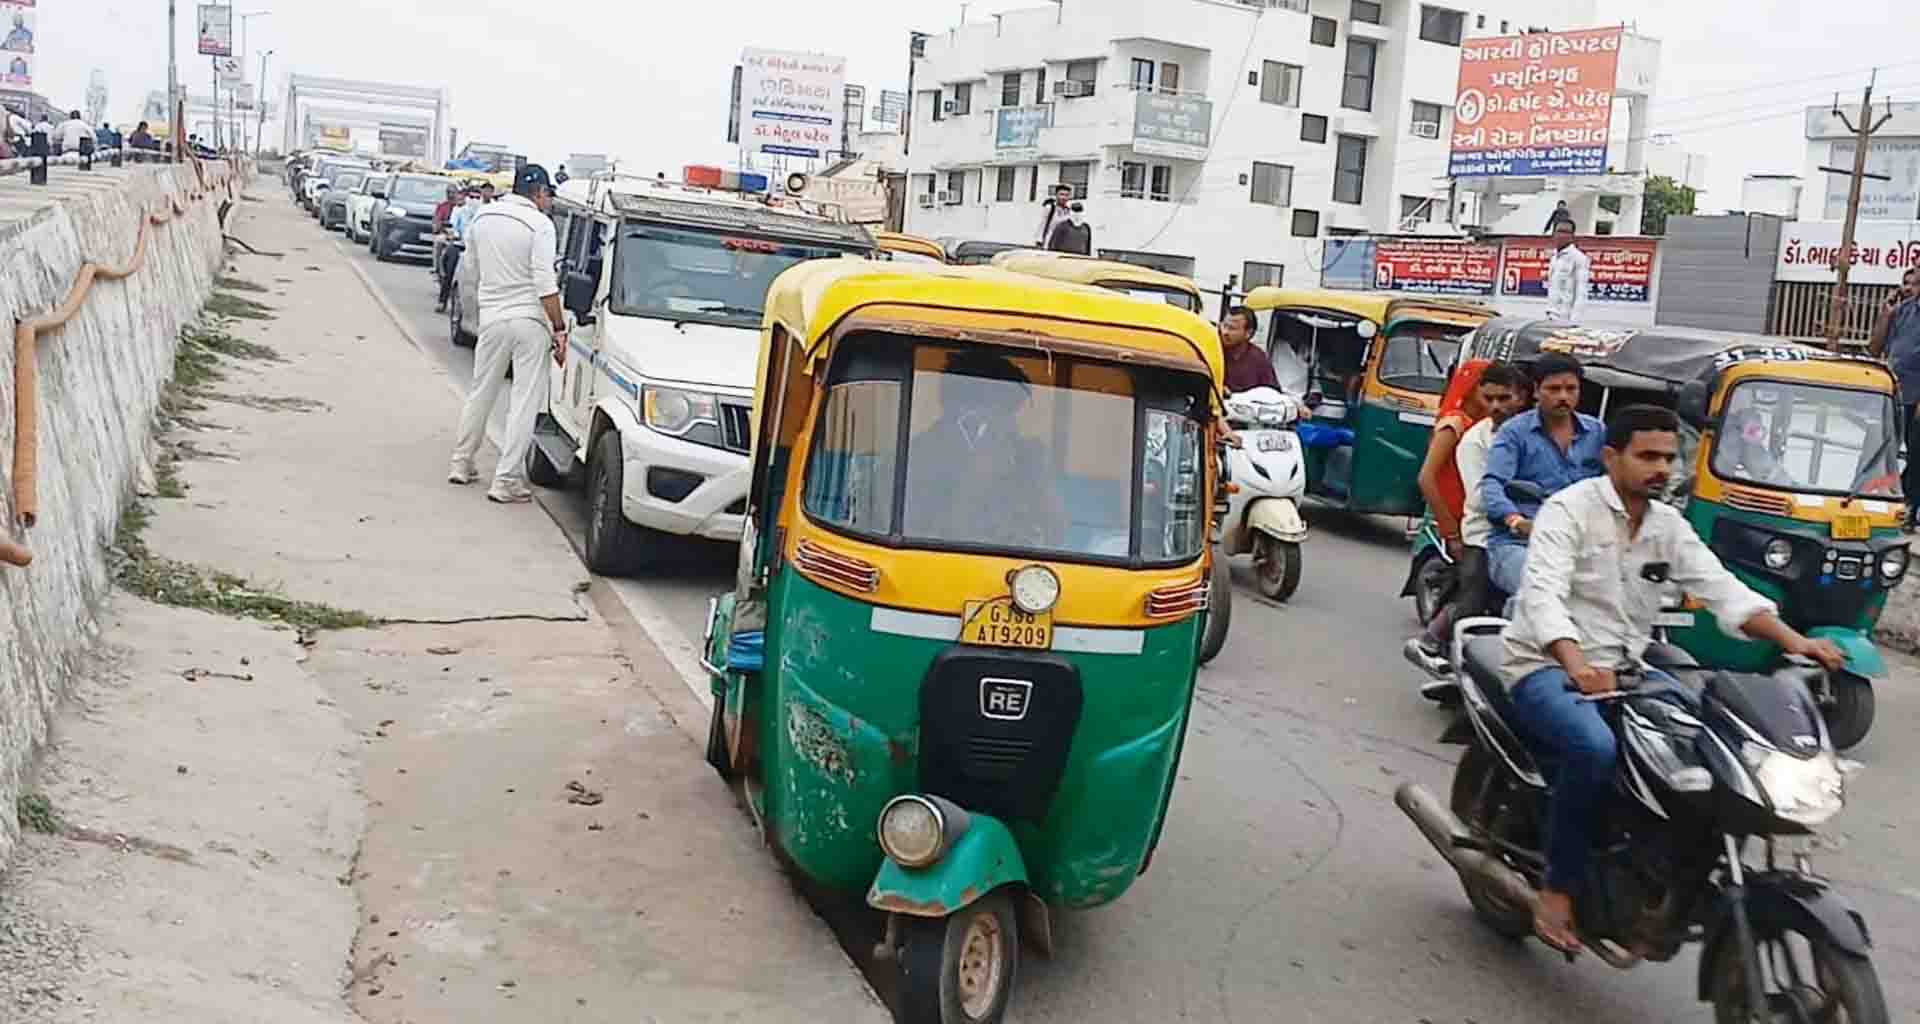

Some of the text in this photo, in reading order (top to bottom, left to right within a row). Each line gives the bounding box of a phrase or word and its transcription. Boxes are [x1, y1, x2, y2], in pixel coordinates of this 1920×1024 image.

[1463, 39, 1522, 61] આરતી
[977, 625, 1046, 645] AT9209
[988, 691, 1022, 712] RE
